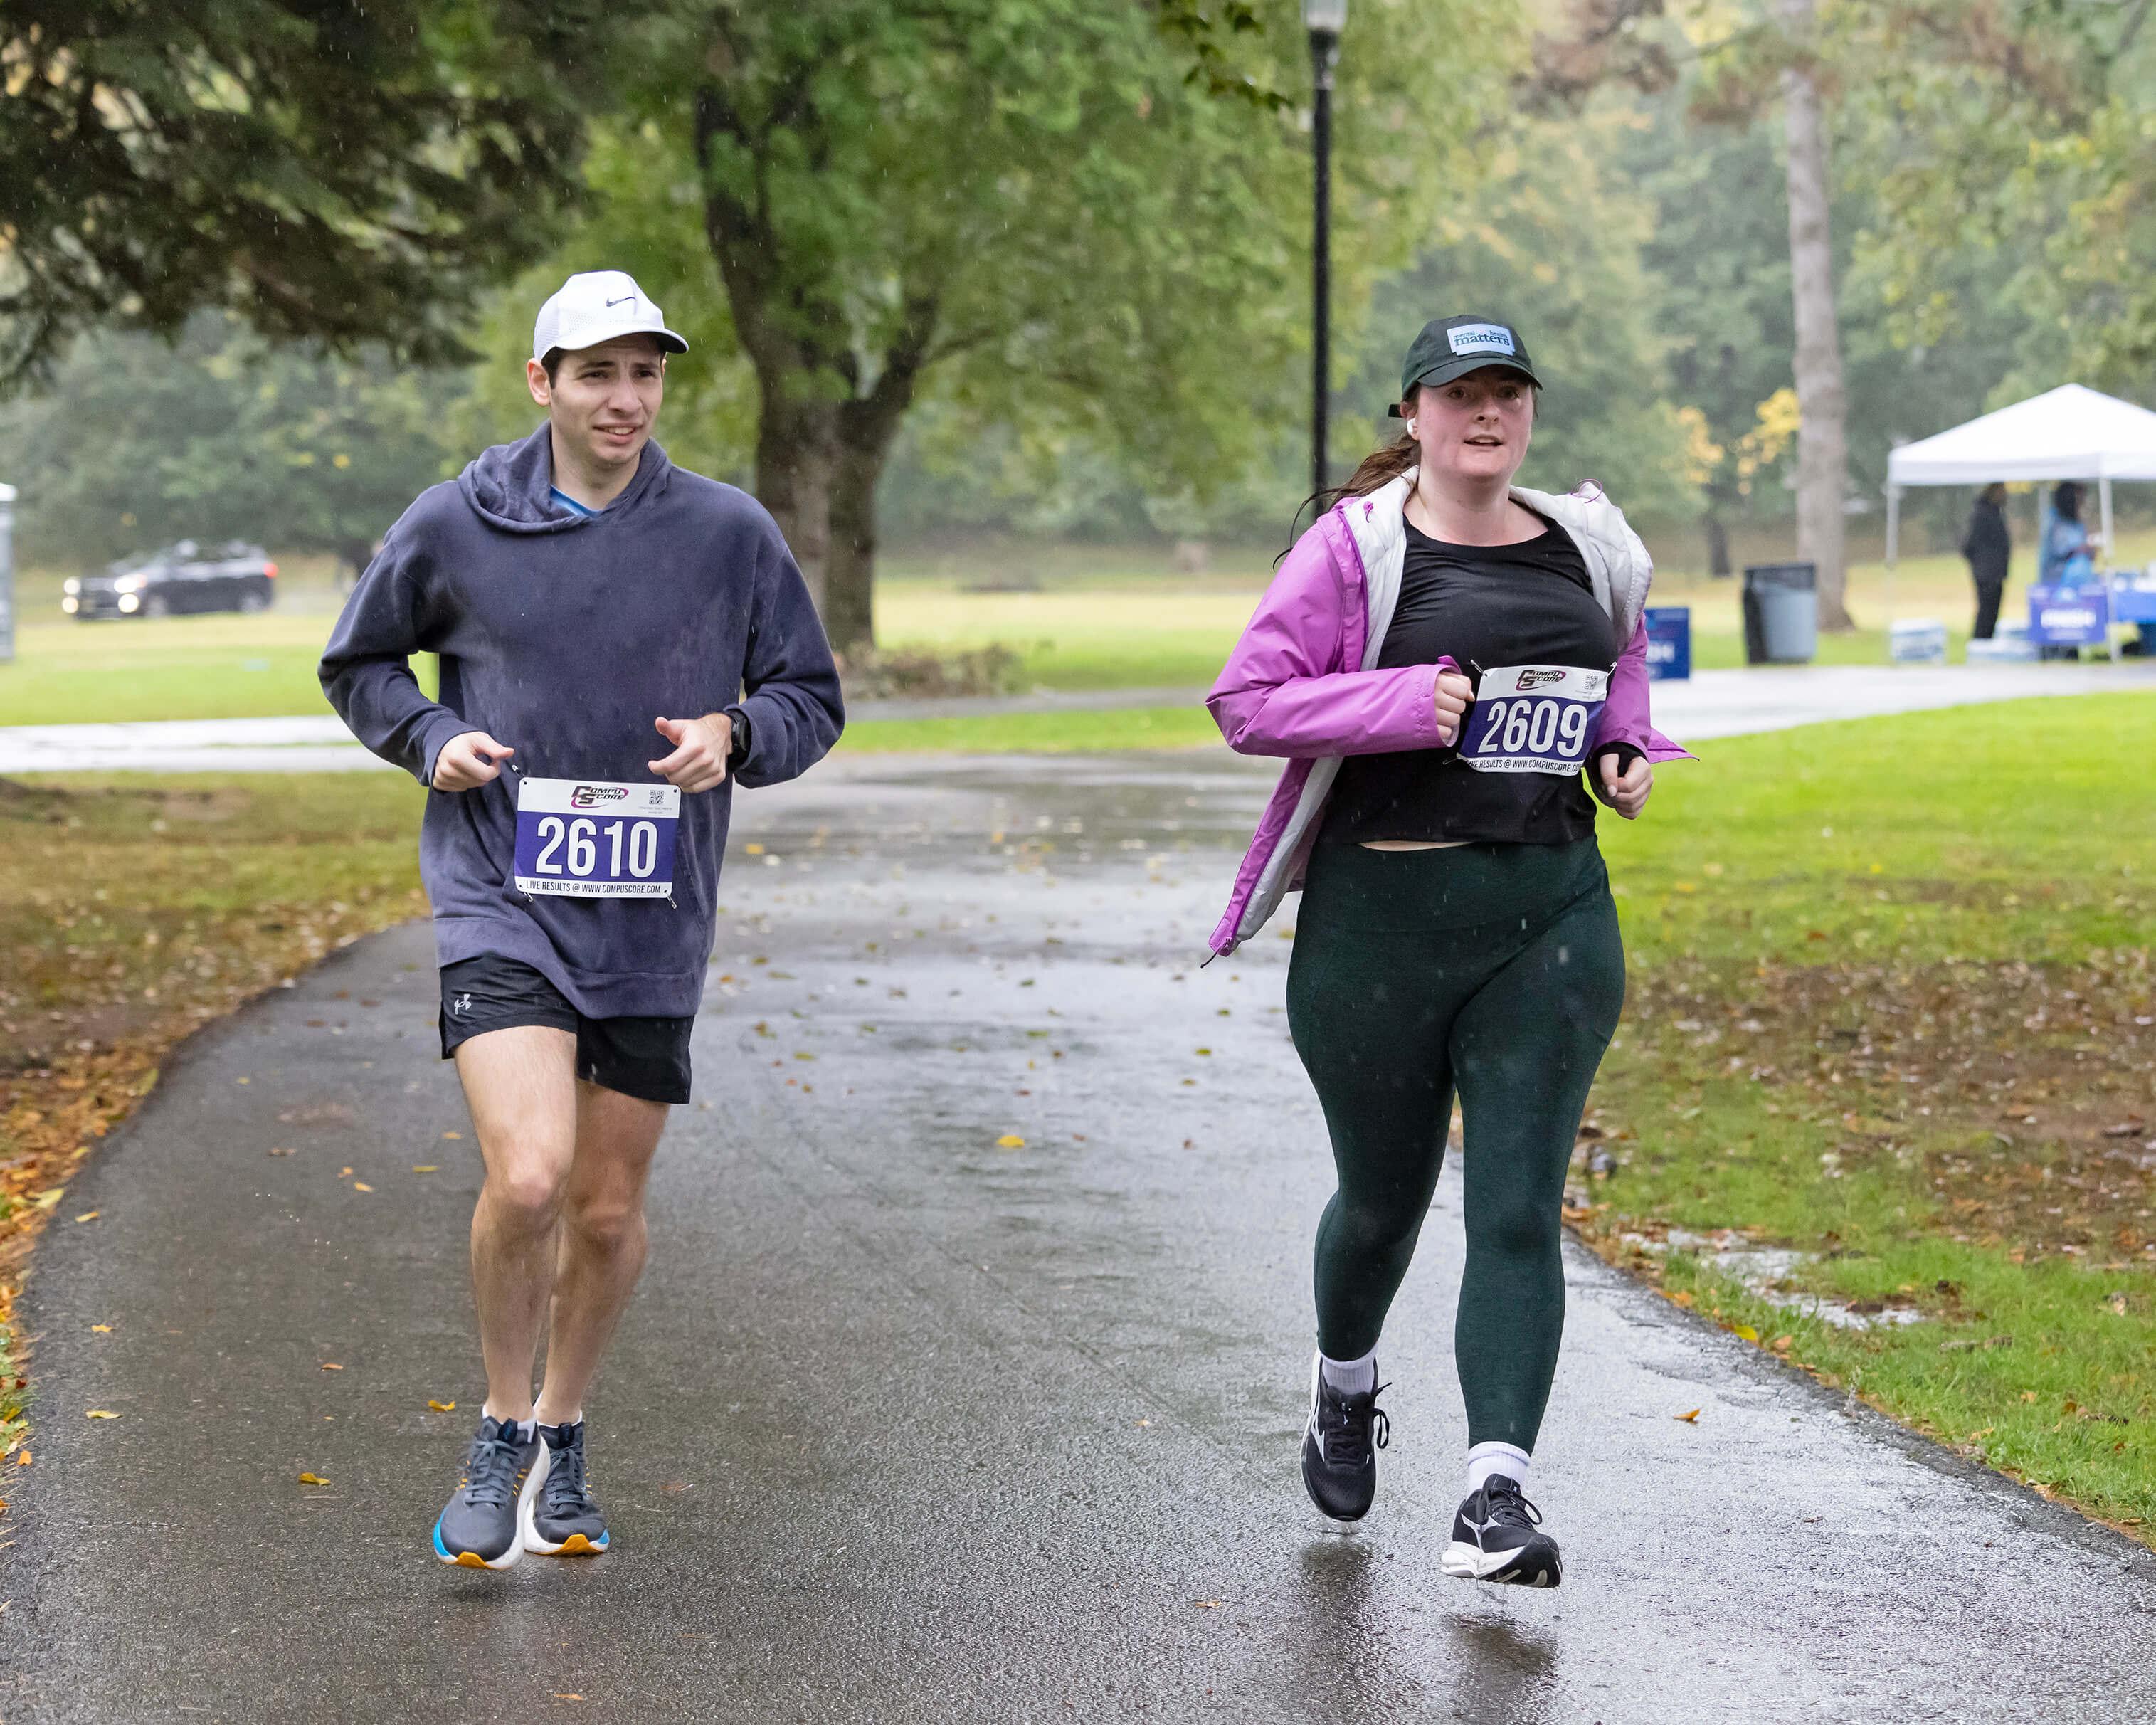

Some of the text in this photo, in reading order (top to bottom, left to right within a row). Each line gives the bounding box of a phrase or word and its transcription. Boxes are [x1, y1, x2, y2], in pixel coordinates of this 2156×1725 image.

[1454, 334, 1510, 346] matters
[1478, 700, 1587, 757] 2609
[1479, 759, 1503, 768] RESULTS
[1504, 759, 1511, 769] @
[571, 786, 621, 797] COMPU
[578, 793, 625, 804] SCORE
[536, 816, 657, 877] 2610
[542, 882, 570, 891] RESULTS
[572, 883, 580, 892] @
[582, 884, 660, 893] WWW.COMPUSCORE.COM
